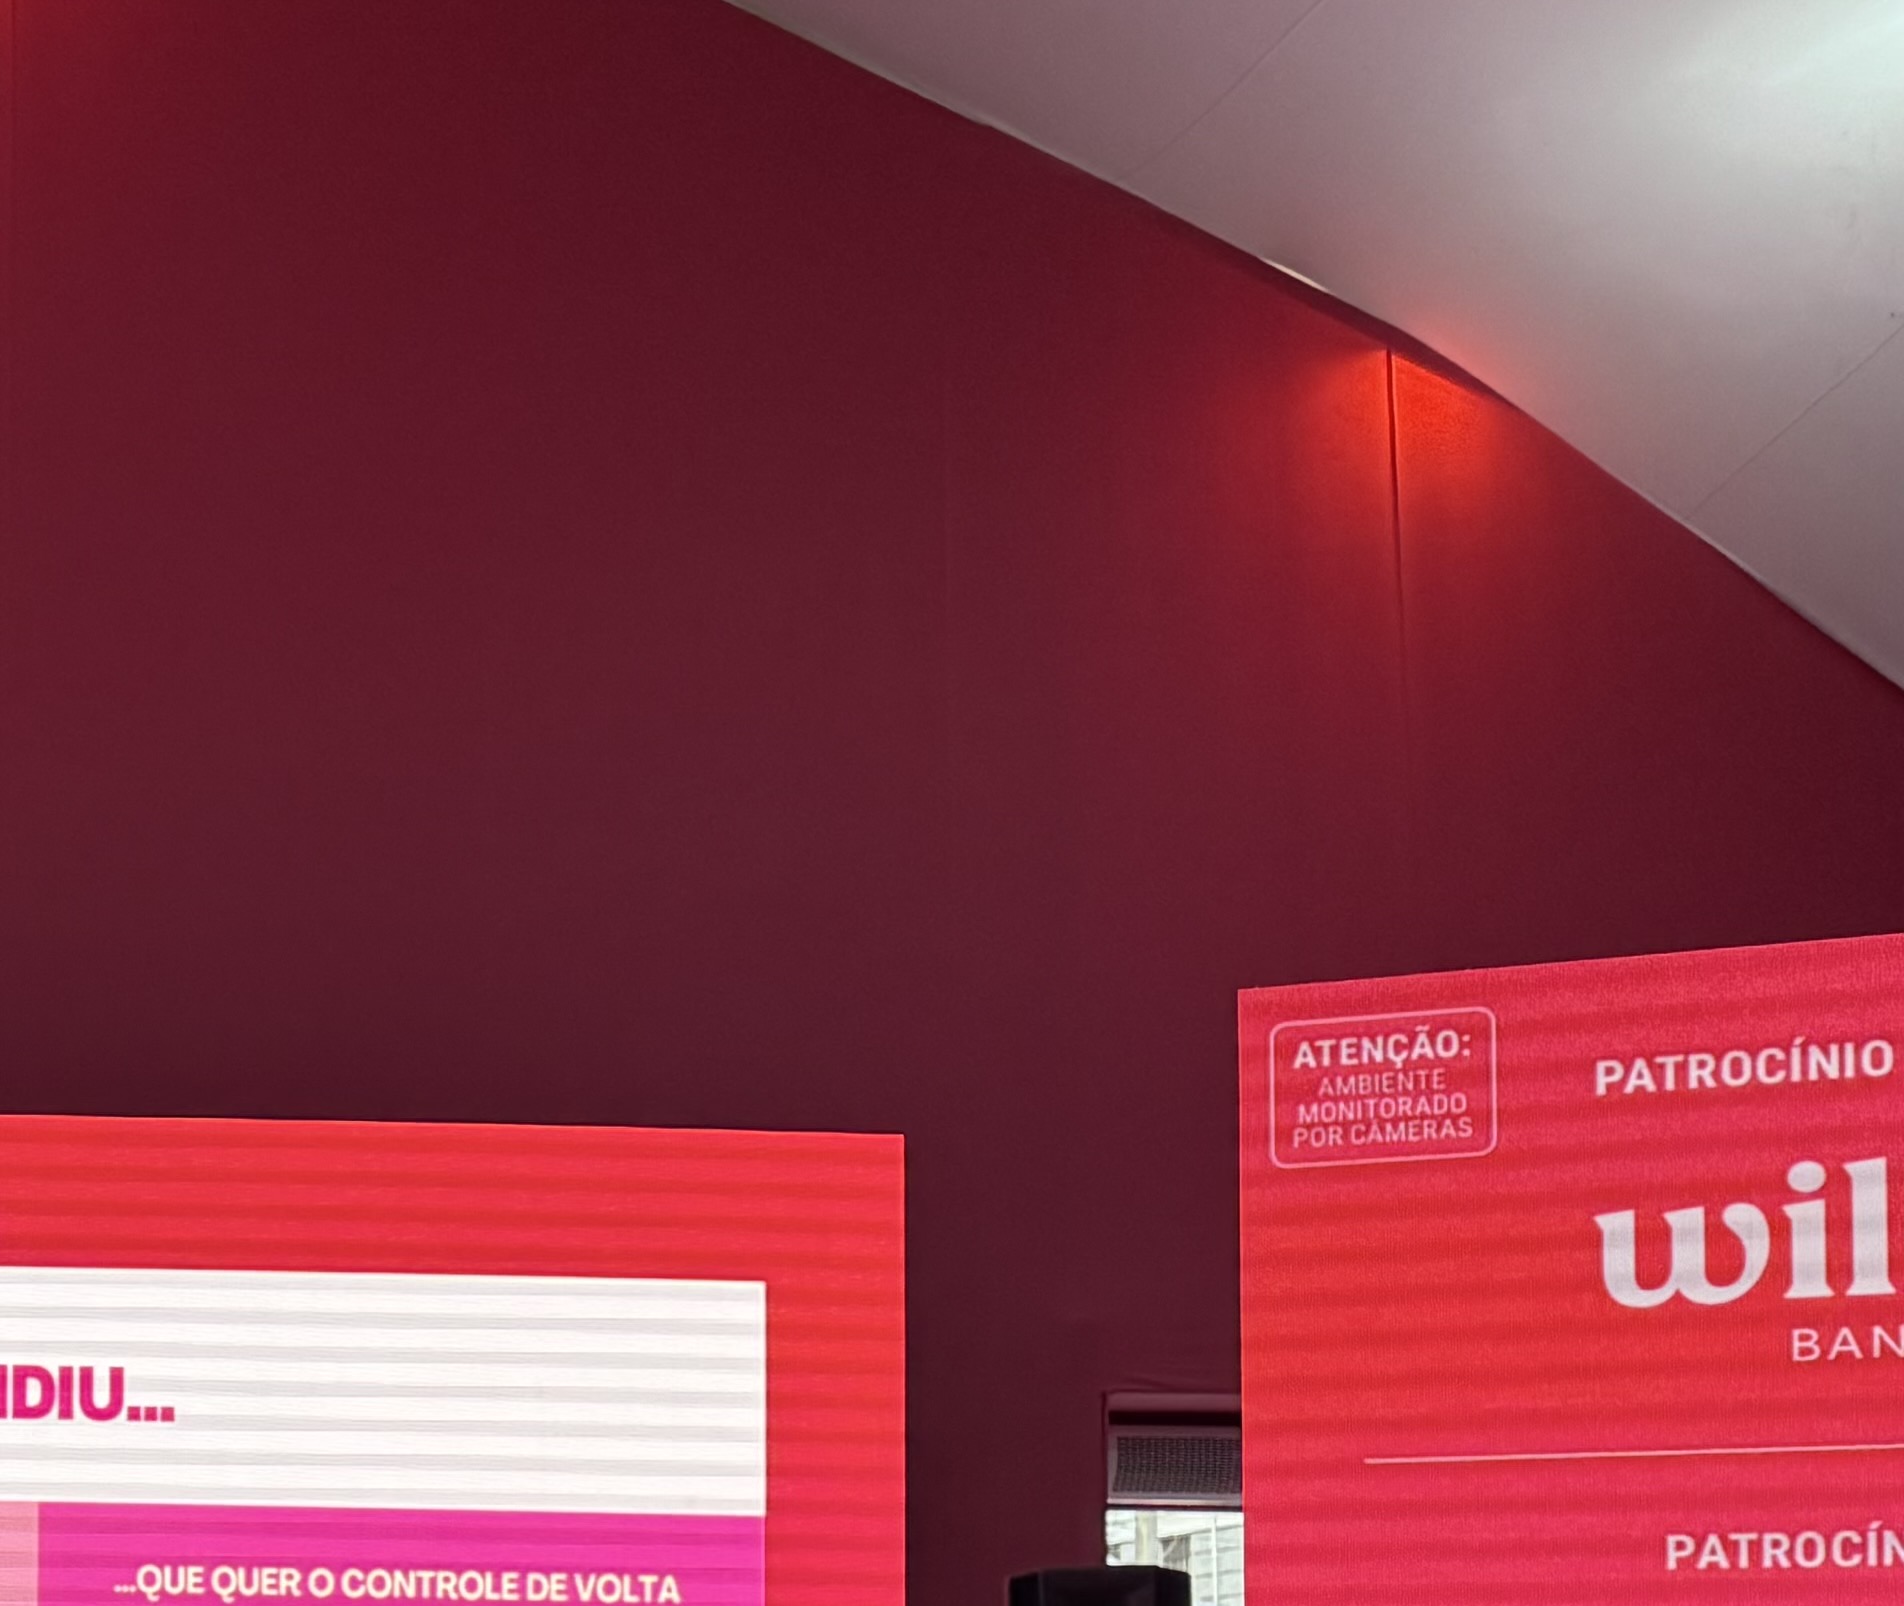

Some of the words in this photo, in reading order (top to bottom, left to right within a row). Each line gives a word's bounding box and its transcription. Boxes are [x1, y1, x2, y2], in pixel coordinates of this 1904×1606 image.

[1293, 1025, 1470, 1069] ATENÇÃO:
[1595, 1037, 1894, 1096] PATROCÍNIO
[1319, 1068, 1446, 1096] AMBIENTE
[1298, 1093, 1467, 1124] MONITORADO
[1293, 1126, 1342, 1148] POR
[1351, 1117, 1473, 1145] CÂMERAS
[1593, 1156, 1896, 1308] wil
[1792, 1324, 1904, 1361] BAN
[1665, 1520, 1904, 1570] PATROCÍN
[114, 1564, 205, 1602] ...QUE
[211, 1566, 301, 1603] QUER
[308, 1568, 335, 1598] O
[341, 1568, 519, 1600] CONTROLE
[527, 1573, 568, 1601] DE
[574, 1573, 681, 1604] VOLTA
